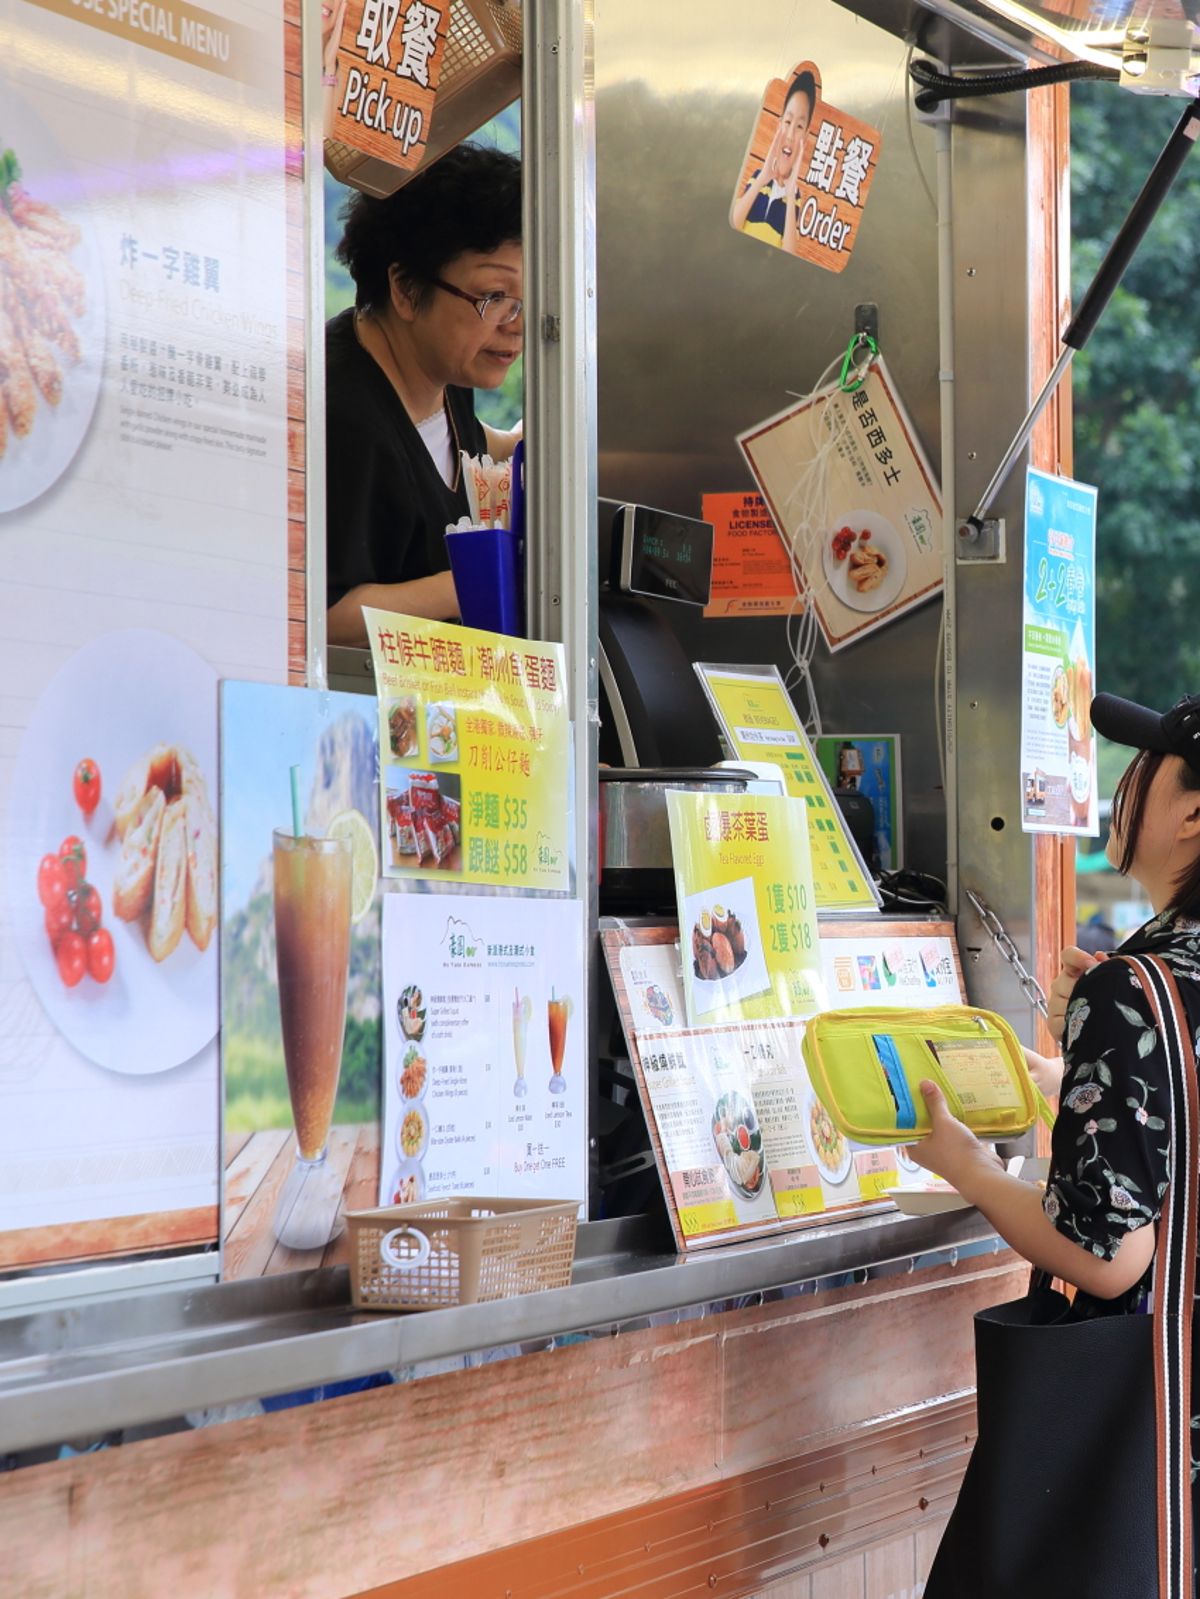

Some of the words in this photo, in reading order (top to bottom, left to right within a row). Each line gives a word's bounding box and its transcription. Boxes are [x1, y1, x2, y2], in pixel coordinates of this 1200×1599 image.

[107, 0, 177, 42] SPECIAL
[181, 17, 230, 61] MENU
[356, 0, 441, 87] 取餐
[341, 69, 391, 132] Pick
[392, 103, 422, 155] up
[806, 120, 874, 207] 點餐
[800, 197, 851, 252] Order
[729, 520, 776, 530] LICENSE
[504, 793, 527, 830] $35
[504, 839, 527, 876] $58
[766, 884, 785, 913] 1隻
[787, 884, 807, 912] $10
[769, 922, 789, 953] 2隻
[791, 921, 811, 950] $18
